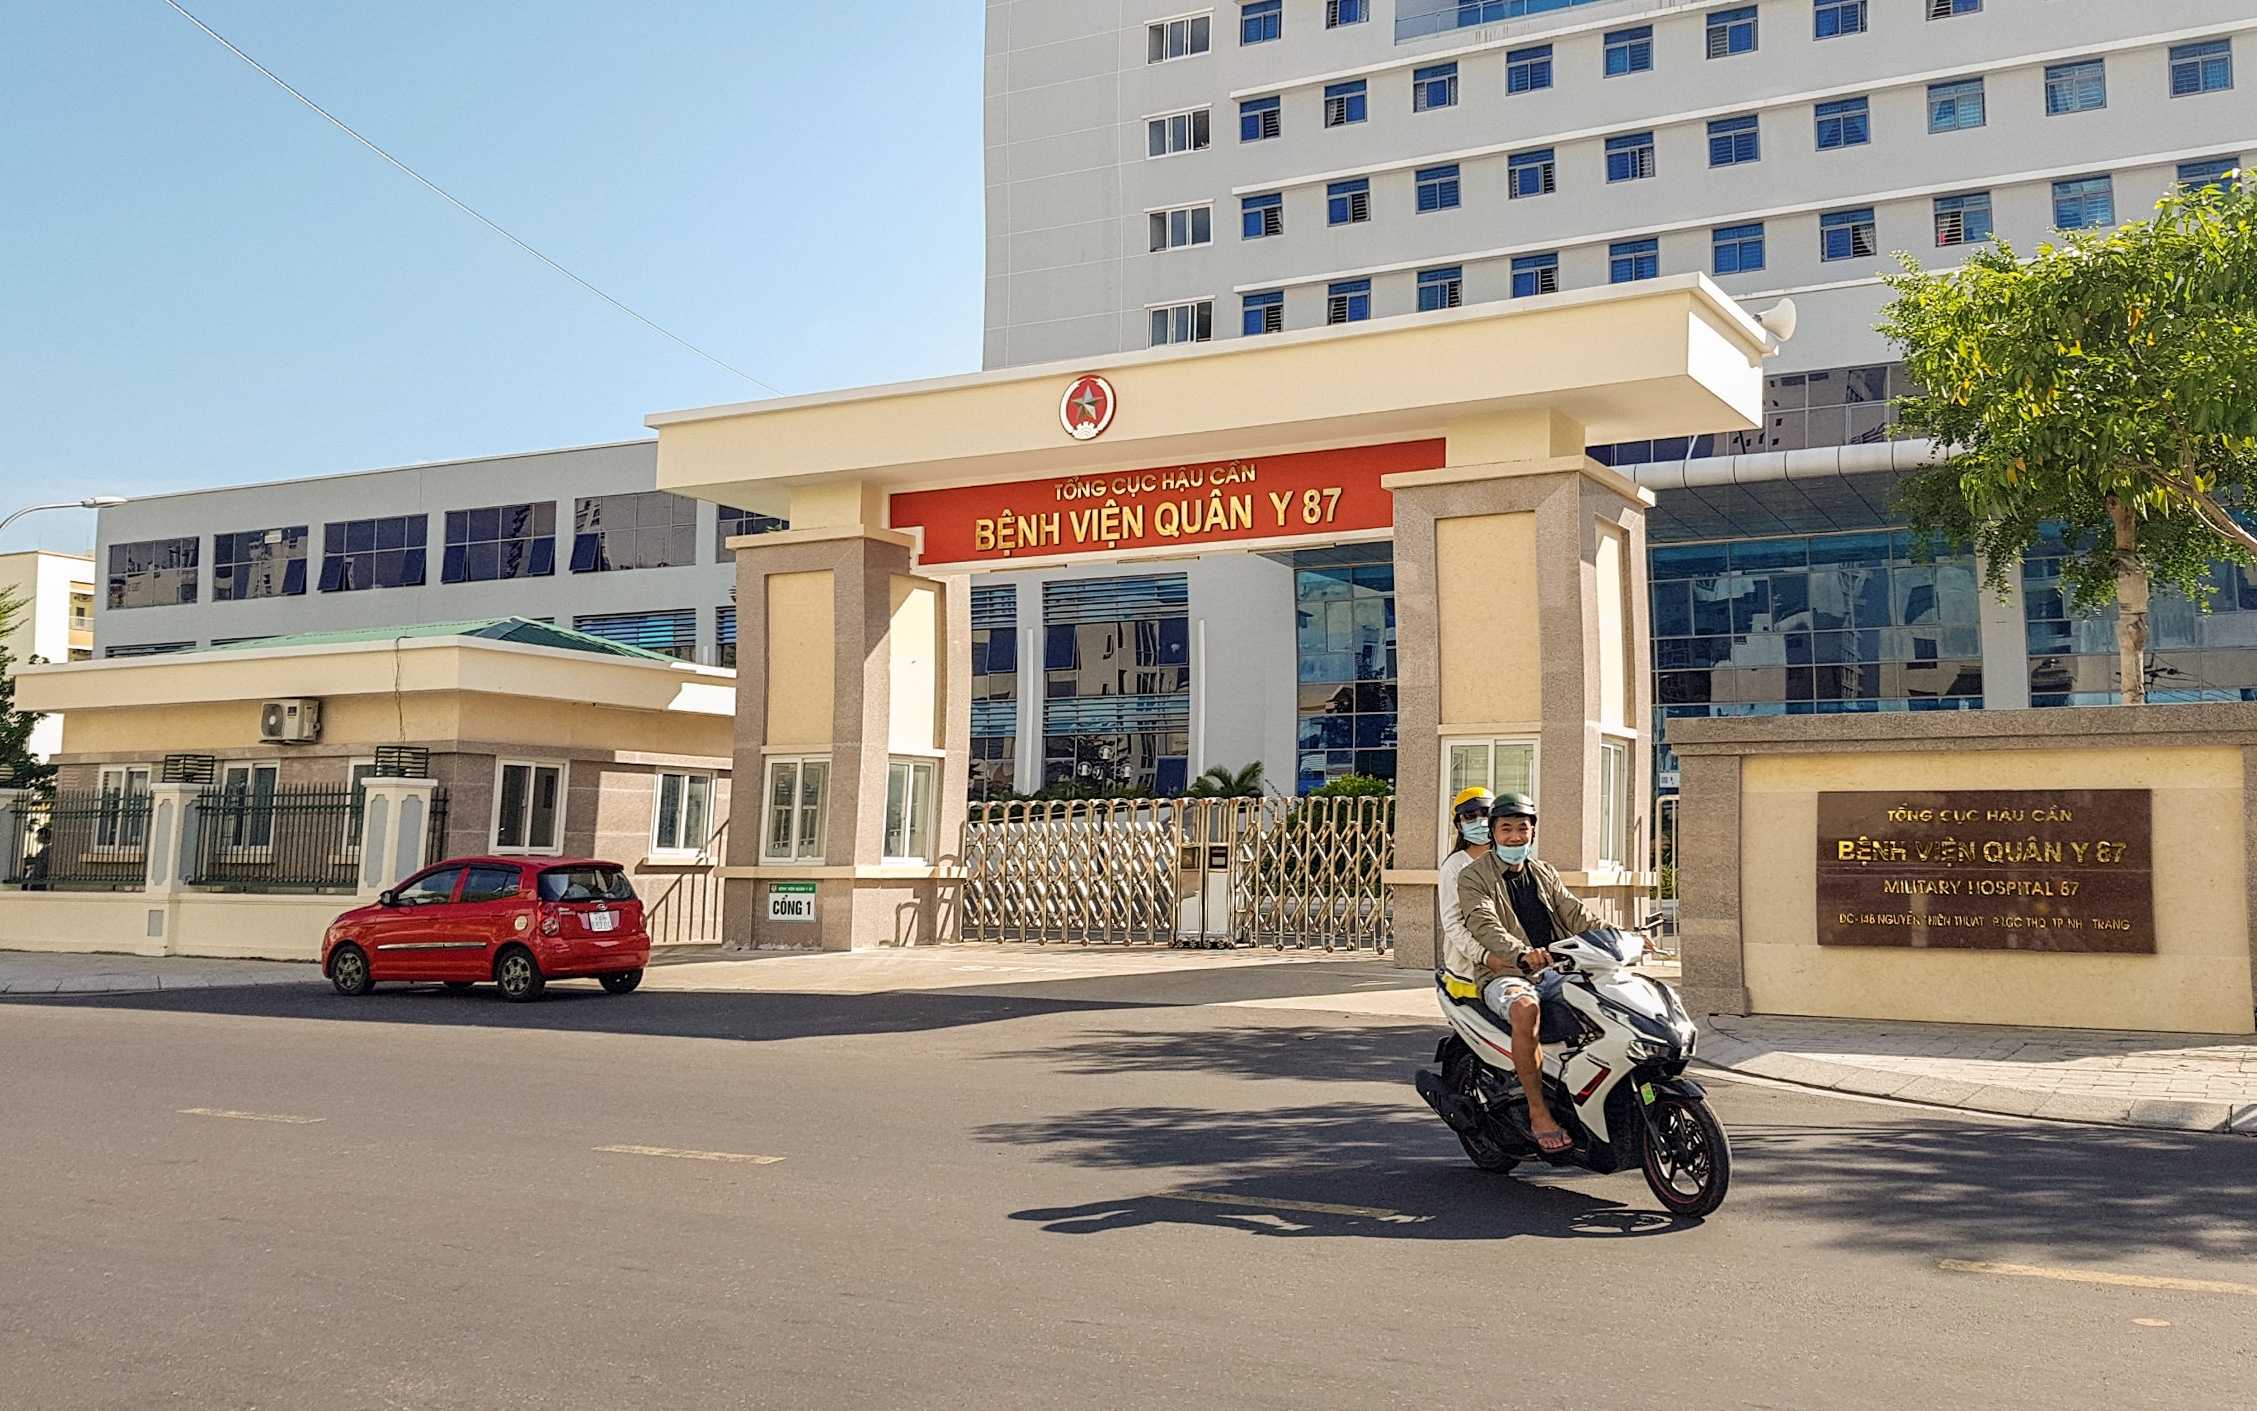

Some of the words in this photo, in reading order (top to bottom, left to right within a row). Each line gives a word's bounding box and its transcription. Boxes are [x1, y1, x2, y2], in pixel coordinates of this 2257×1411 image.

[1054, 475, 1107, 501] TỔNG
[1111, 473, 1157, 498] CỤC
[1161, 466, 1204, 493] HẬU
[1209, 460, 1256, 485] CẦN
[975, 508, 1061, 557] BỆNH
[1069, 498, 1144, 549] VIỆN
[1153, 488, 1253, 538] QUÂN
[1268, 490, 1294, 526] Y
[1302, 486, 1343, 524] 87
[1887, 802, 1933, 822] TỔNG
[1939, 809, 1979, 824] CỤC
[2031, 804, 2073, 822] CẦN
[1837, 835, 1907, 866] BỆNH
[1915, 836, 1976, 867] VIỆN
[1983, 836, 2063, 863] QUÂN
[2070, 841, 2090, 863] Y
[2096, 841, 2127, 863] 87
[1884, 879, 1961, 895] MILITARY
[1968, 879, 2054, 897] HOSPITAL
[806, 900, 811, 915] 1
[2092, 918, 2131, 930] TRANG
